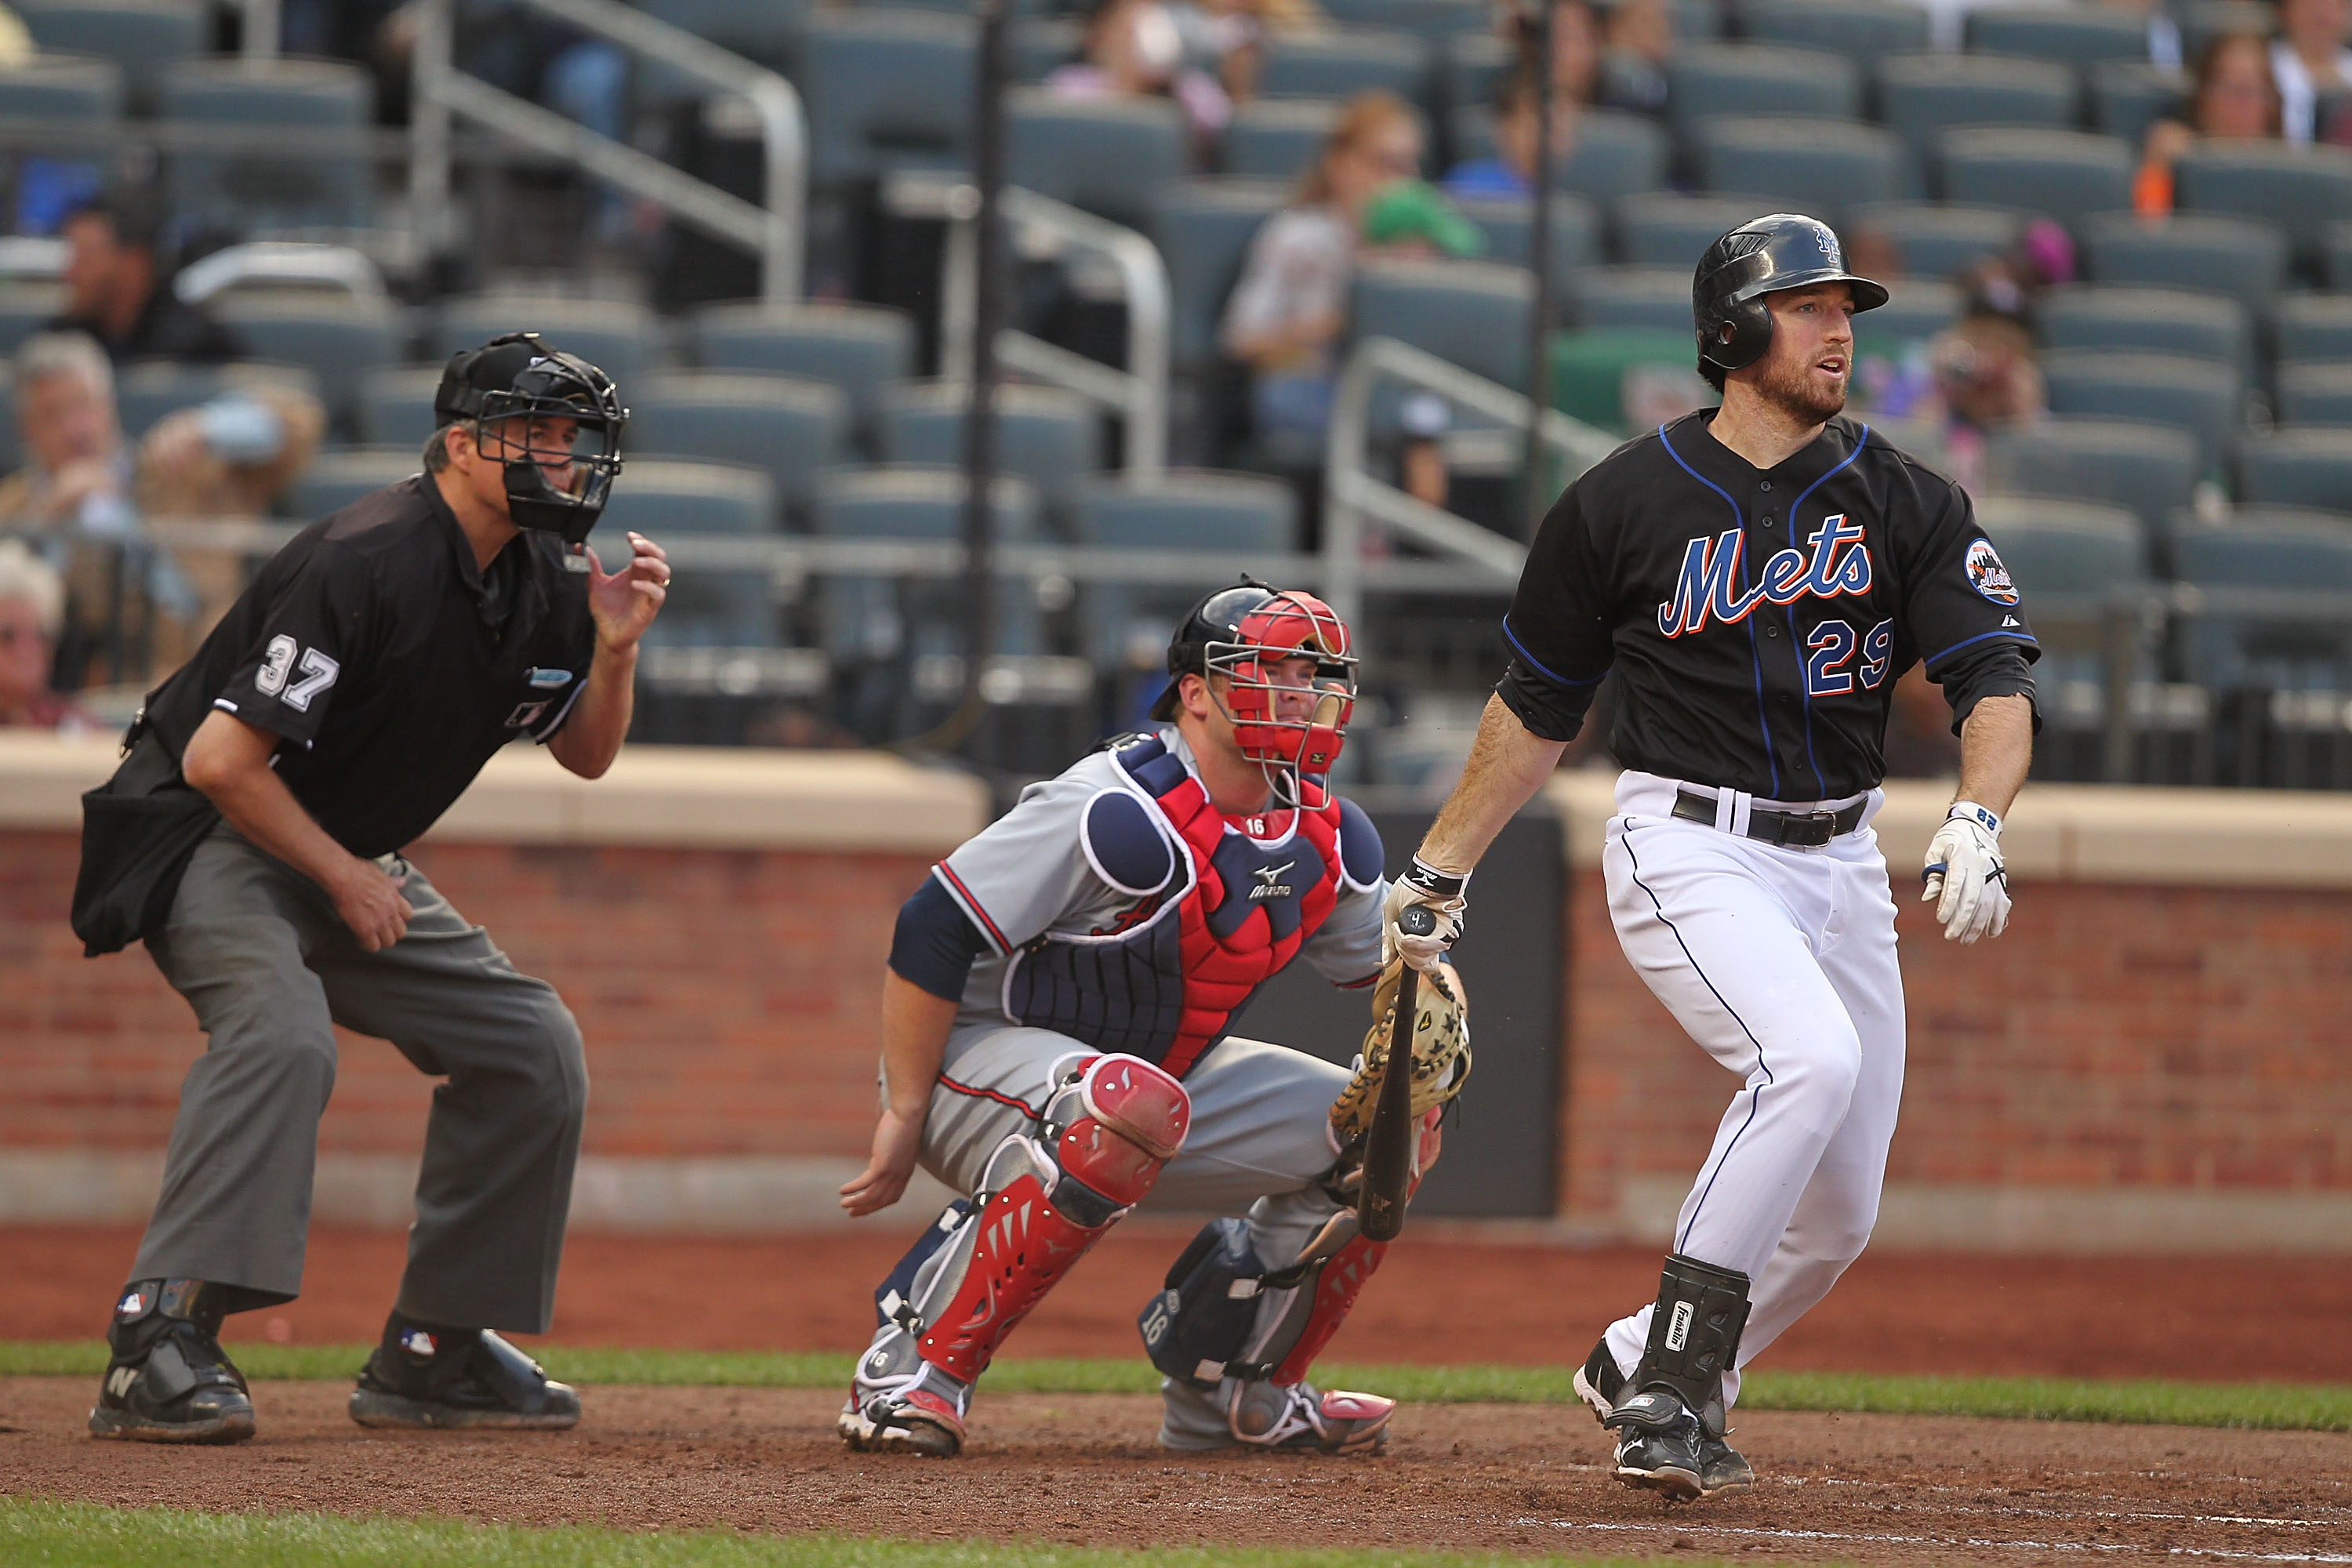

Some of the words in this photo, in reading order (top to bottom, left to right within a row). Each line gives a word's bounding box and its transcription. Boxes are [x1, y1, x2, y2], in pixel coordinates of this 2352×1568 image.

[1657, 514, 1872, 637] Mets
[255, 633, 341, 713] 37
[1806, 618, 1894, 697] 29
[1245, 818, 1265, 836] 16
[1142, 1301, 1168, 1346] 16
[869, 1350, 889, 1367] 16
